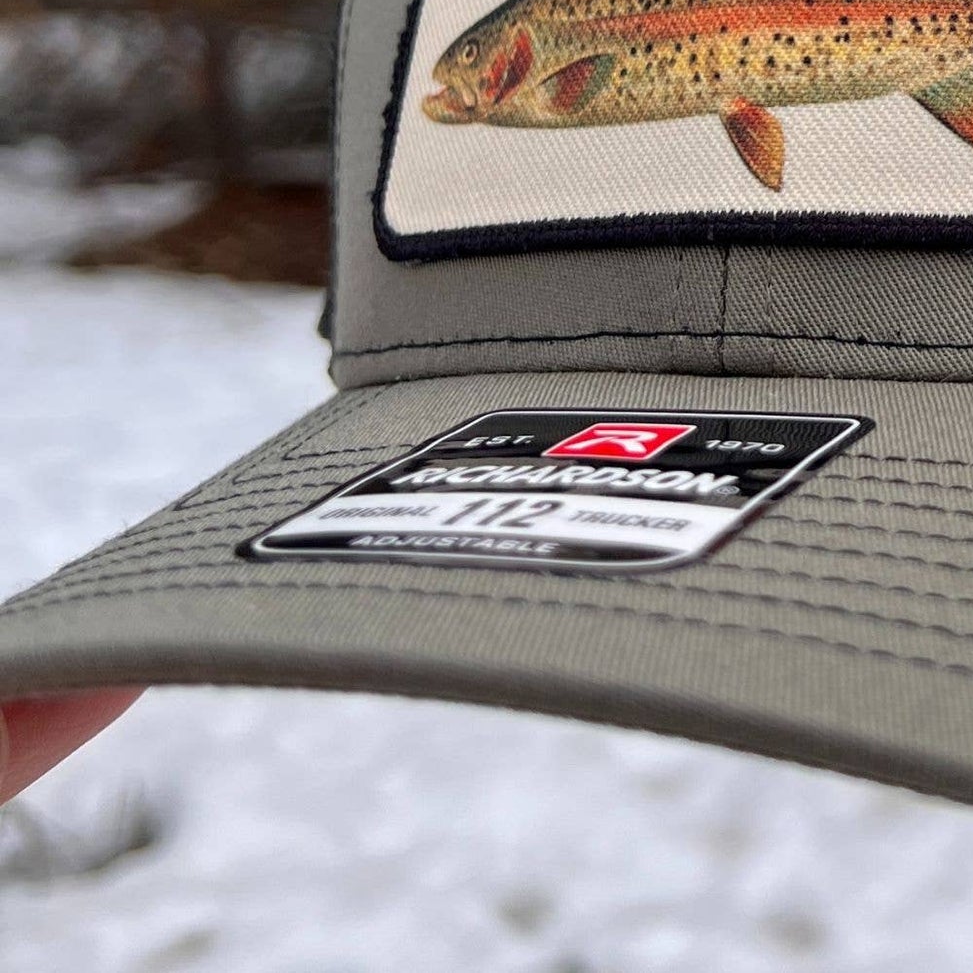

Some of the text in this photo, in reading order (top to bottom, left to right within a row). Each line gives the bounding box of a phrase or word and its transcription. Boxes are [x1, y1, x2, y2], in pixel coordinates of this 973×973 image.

[463, 434, 535, 448] EST.
[705, 439, 785, 455] 1970
[318, 498, 692, 531] ORIGINAL 112 TRUCKER
[349, 535, 560, 554] ADJUSTABLE
